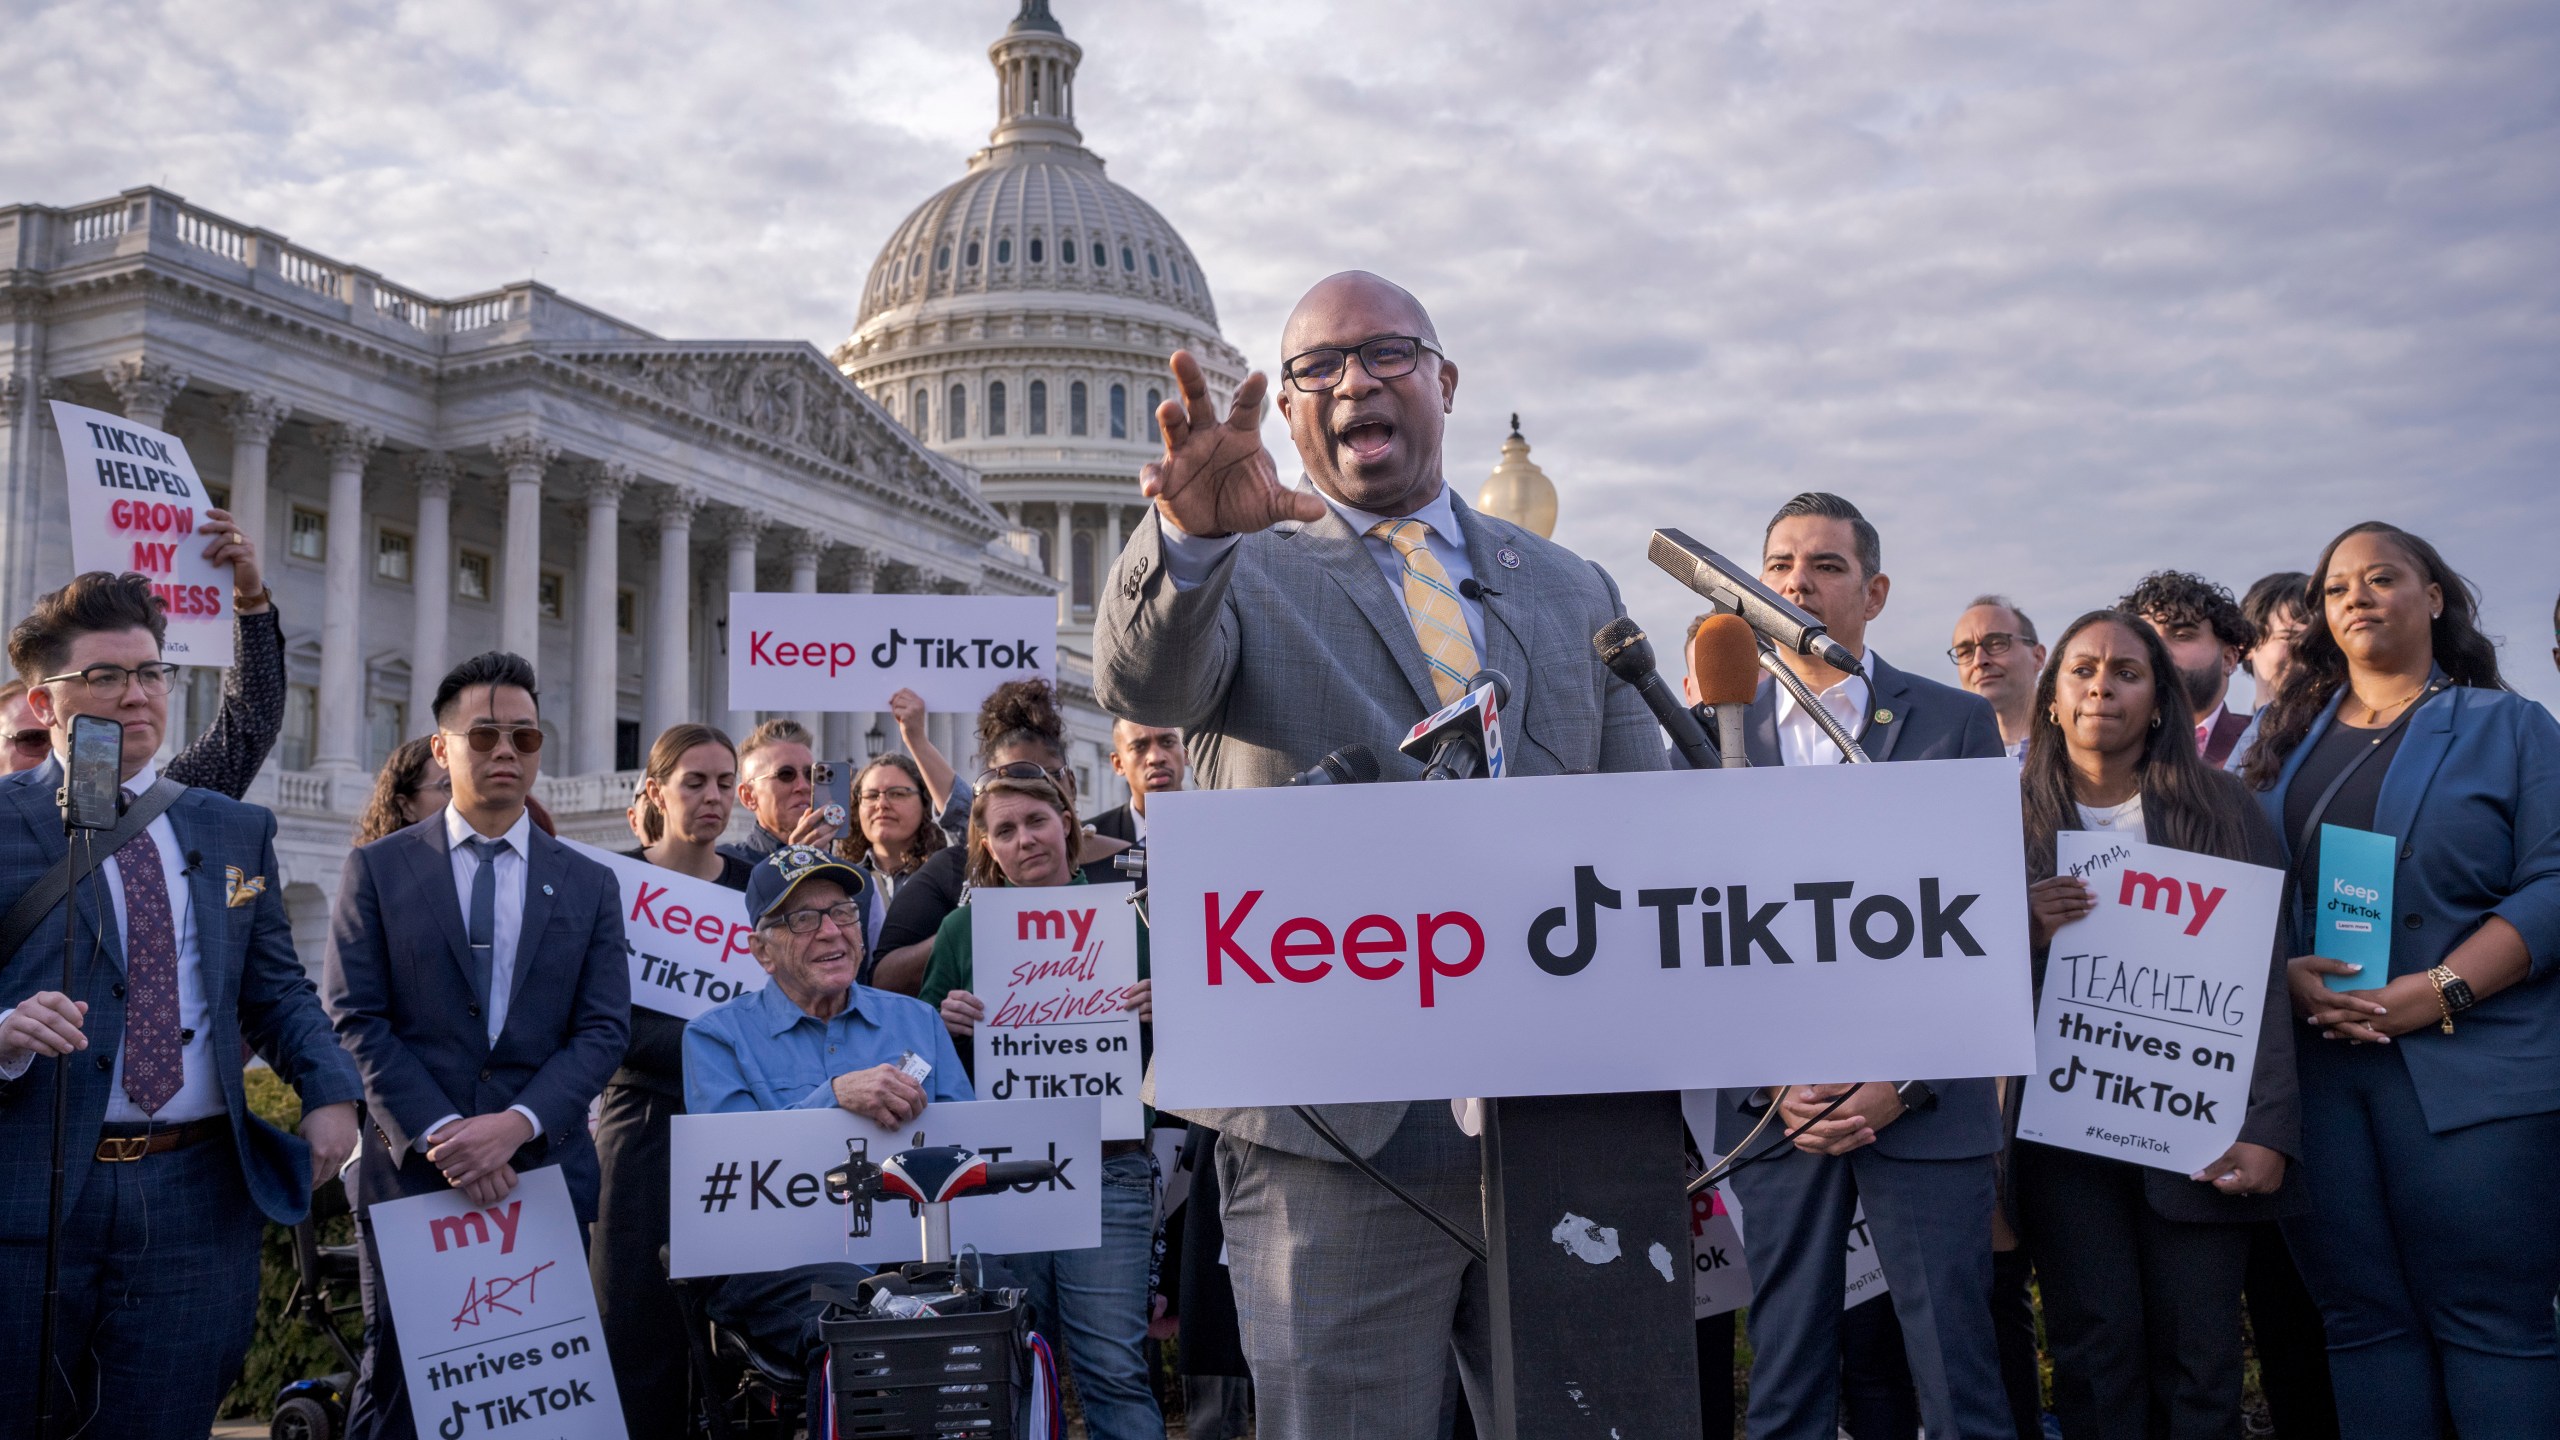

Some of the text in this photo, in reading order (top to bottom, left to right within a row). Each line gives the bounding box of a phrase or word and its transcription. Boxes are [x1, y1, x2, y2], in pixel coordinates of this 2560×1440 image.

[86, 421, 176, 467] TIKTOK
[96, 458, 191, 498] HELPED
[111, 498, 194, 535] GROW
[133, 541, 178, 573] MY
[150, 583, 221, 616] NESS
[750, 631, 1040, 678] Keep TikTok
[2119, 869, 2227, 937] my
[2334, 878, 2379, 904] Keep
[2341, 902, 2381, 920] TikTok
[630, 881, 753, 964] Keep
[1018, 908, 1097, 952] my
[1204, 877, 1987, 1008] Keep TikTok
[1008, 940, 1104, 988] small
[2061, 954, 2244, 1026] TEACHING
[991, 1033, 1128, 1056] thrives on
[2059, 1012, 2235, 1073] thrives on
[1024, 1072, 1123, 1098] TikTok
[2093, 1068, 2220, 1125] TikTok
[2086, 1126, 2171, 1155] #KeepTikTok
[429, 1200, 522, 1255] my
[451, 1261, 555, 1332] ART
[427, 1335, 591, 1391] thrives on
[475, 1378, 596, 1430] TikTok
